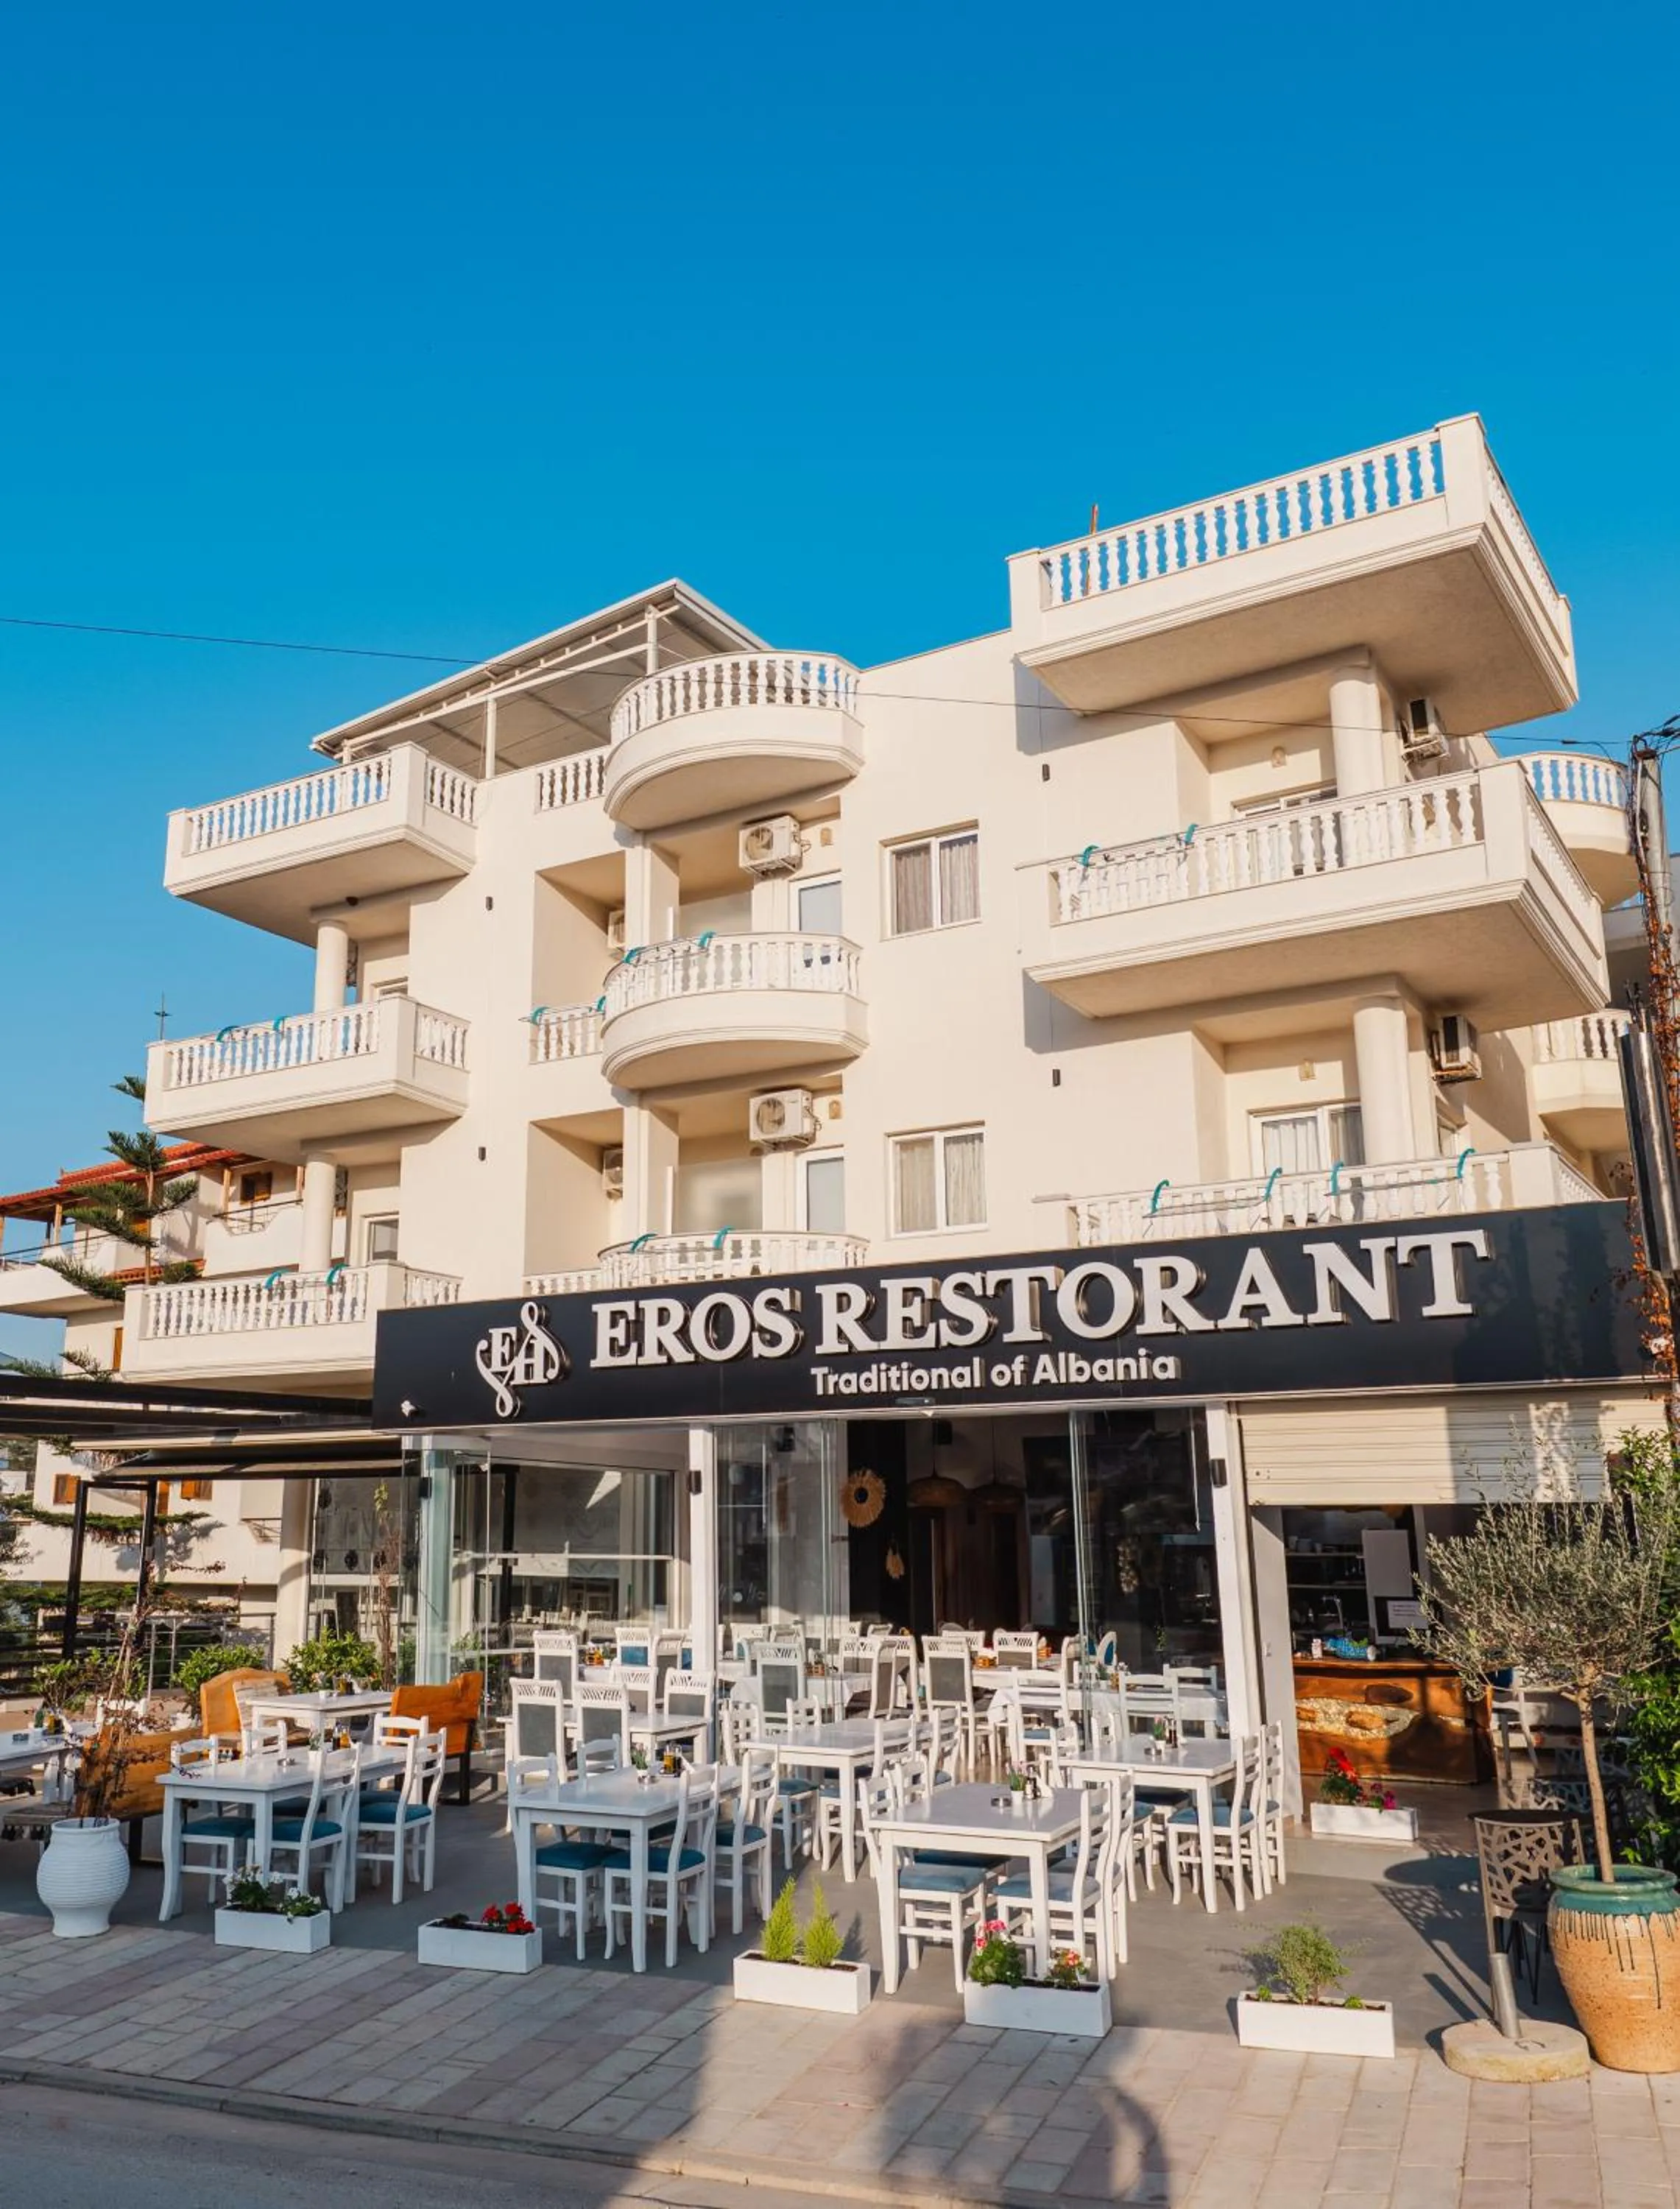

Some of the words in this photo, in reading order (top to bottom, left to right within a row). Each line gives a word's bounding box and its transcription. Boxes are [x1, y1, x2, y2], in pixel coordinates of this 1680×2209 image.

[590, 1287, 800, 1368] EROS
[814, 1229, 1492, 1355] RESTORANT
[811, 1357, 982, 1395] Traditional
[990, 1354, 1026, 1387] of
[1032, 1347, 1178, 1384] Albania
